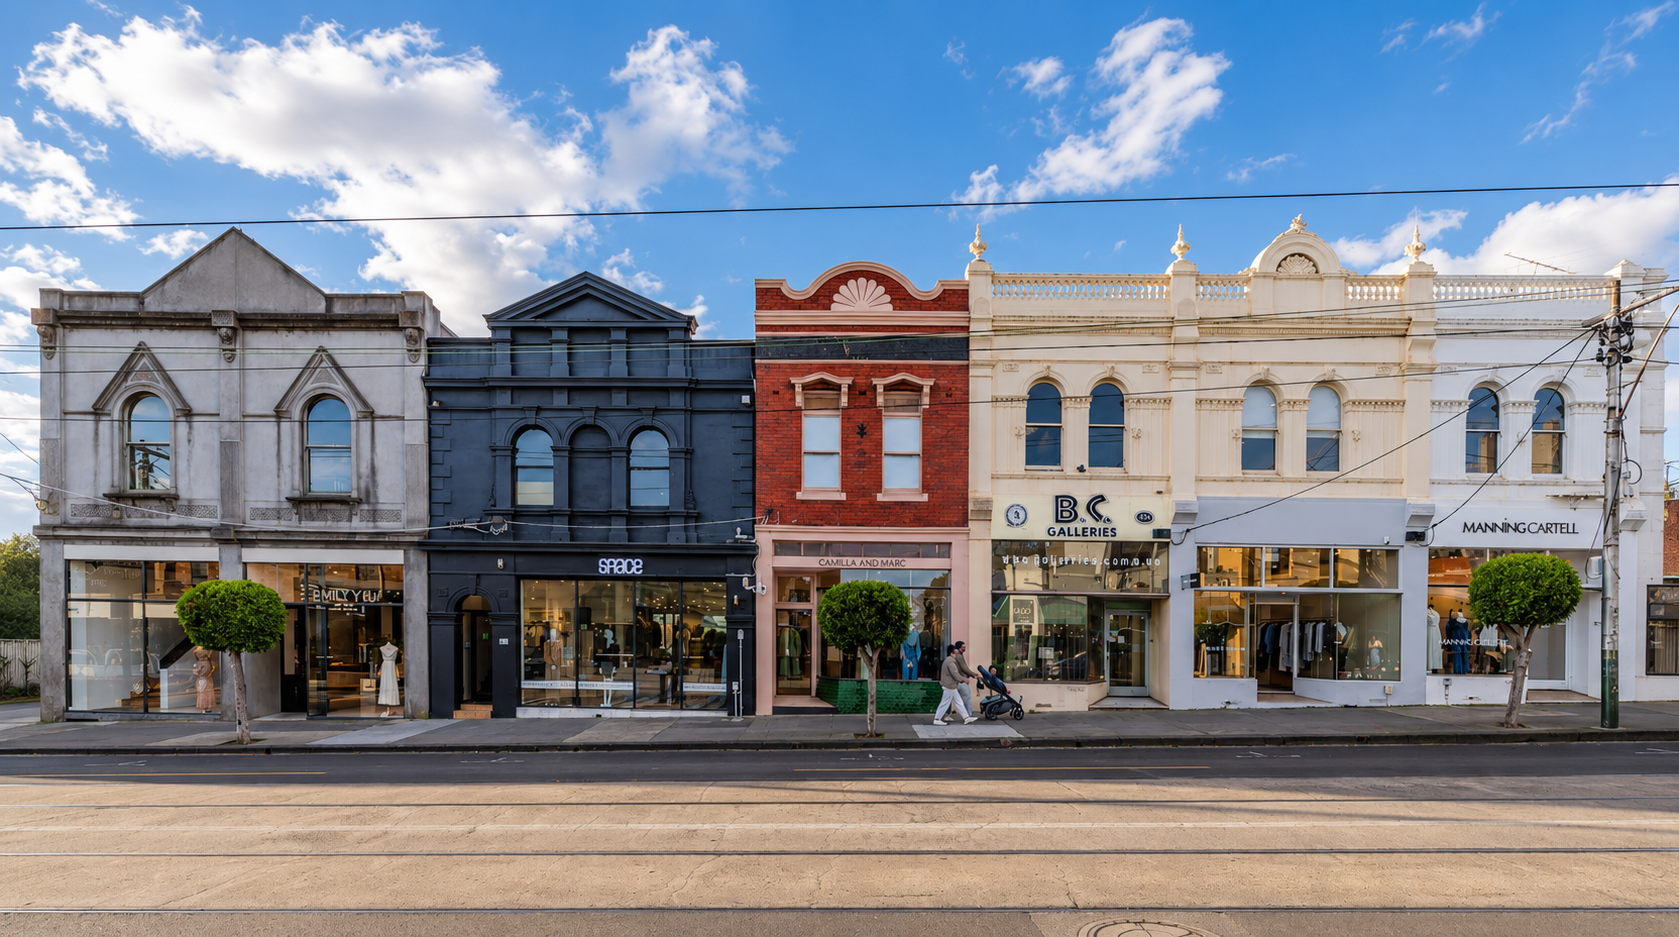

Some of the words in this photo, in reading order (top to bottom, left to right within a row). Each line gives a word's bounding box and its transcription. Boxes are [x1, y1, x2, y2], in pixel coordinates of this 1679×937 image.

[1047, 526, 1117, 537] GALLERIES
[818, 558, 857, 567] CAMILLA
[859, 559, 879, 567] AND
